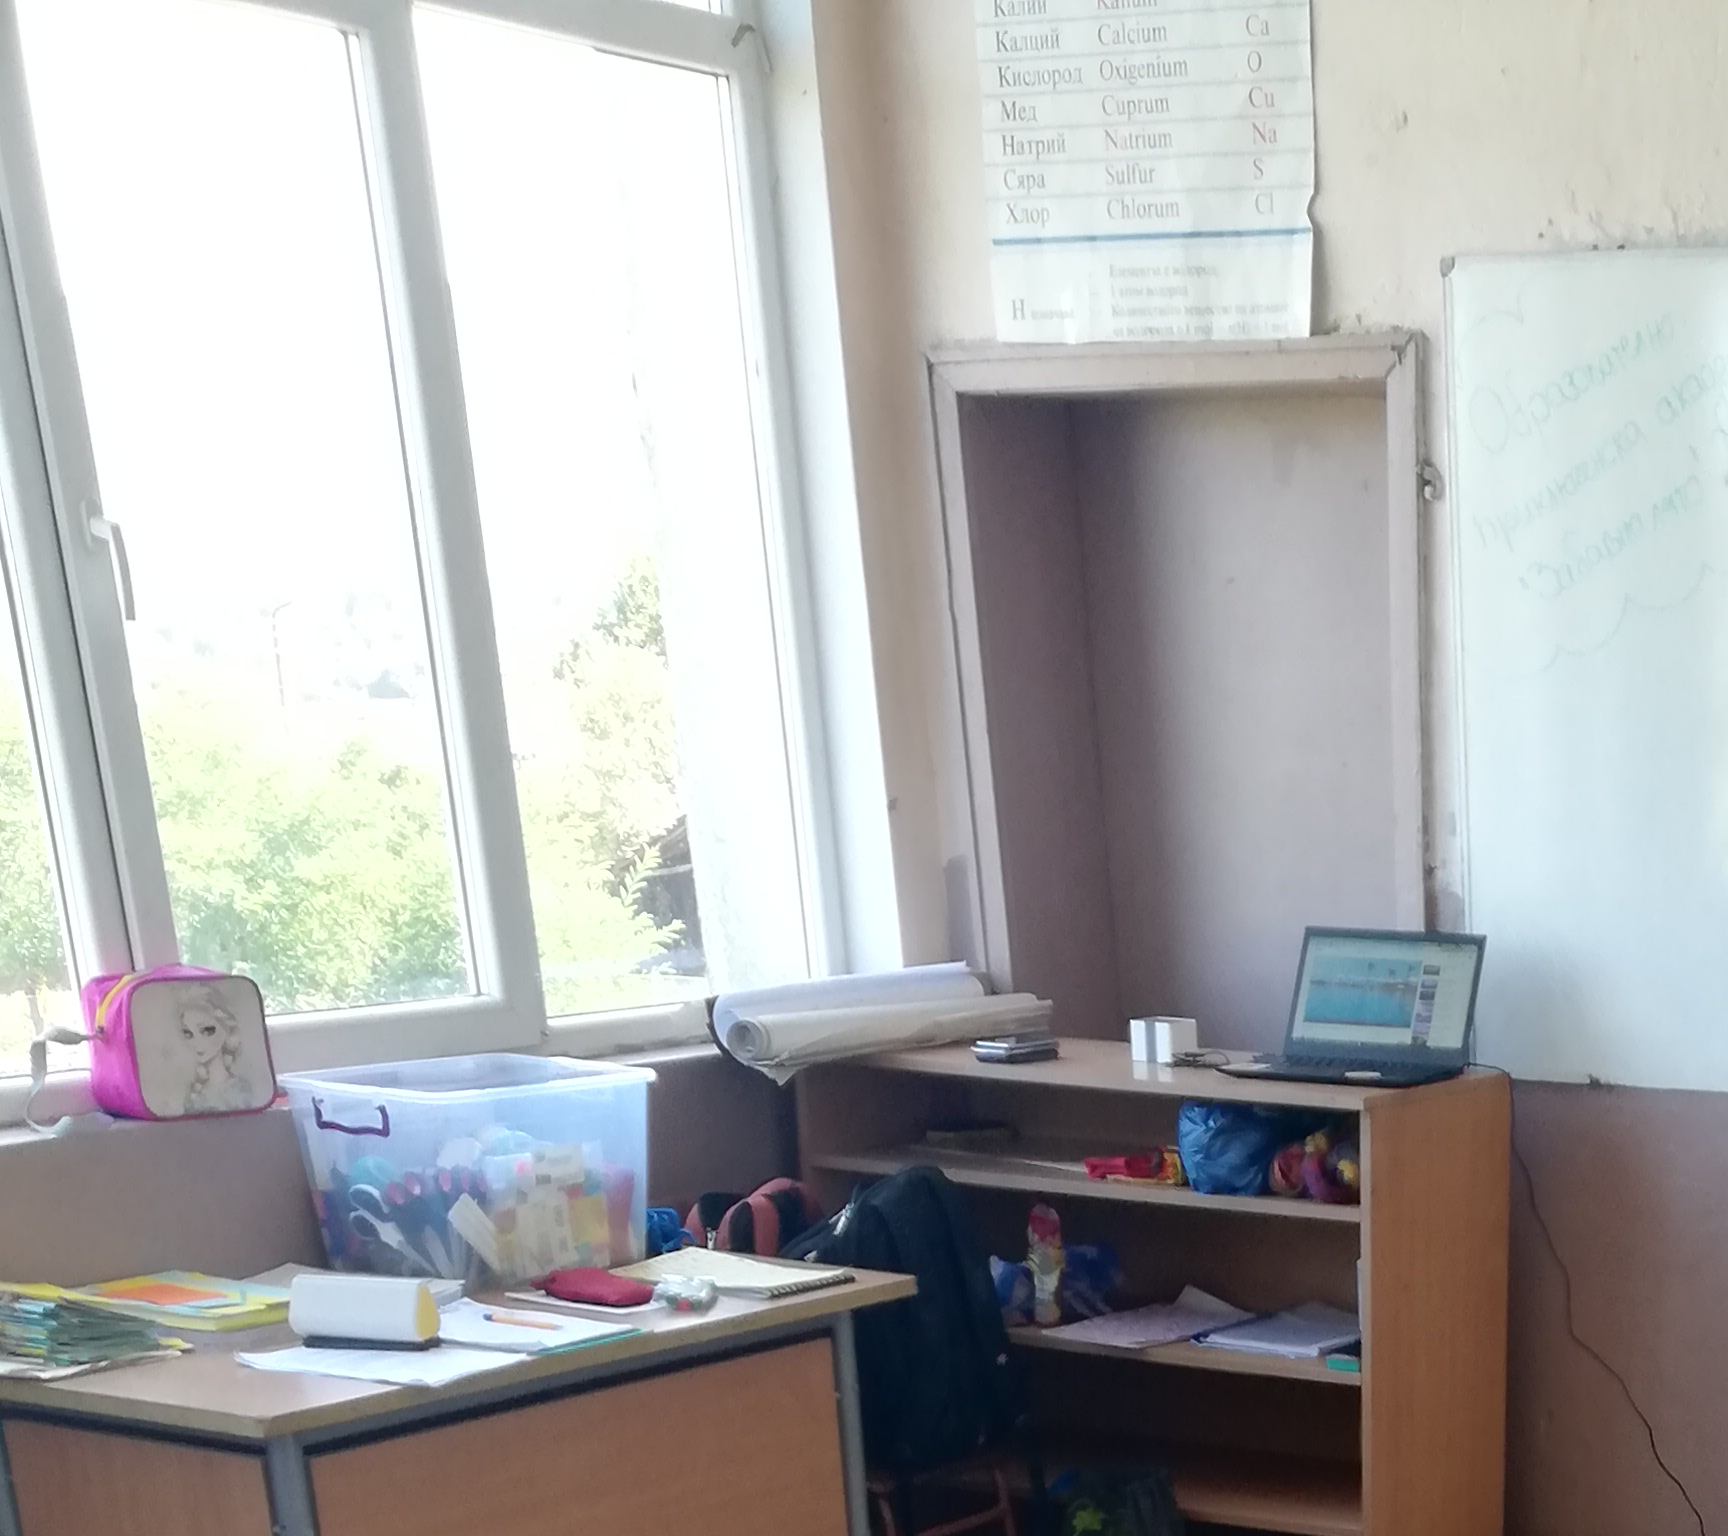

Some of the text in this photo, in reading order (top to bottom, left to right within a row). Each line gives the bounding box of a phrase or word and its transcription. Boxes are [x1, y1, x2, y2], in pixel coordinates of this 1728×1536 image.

[995, 14, 1270, 53] Калций Calcium Ca
[998, 50, 1263, 91] Кислород Oxigenium O
[1001, 86, 1275, 123] Мед Cuprum Cu
[1002, 121, 1277, 159] Натрий Natrium Na
[1003, 158, 1264, 191] Сяра Sulfur S
[1005, 191, 1274, 226] Хлор Chlorum Cl
